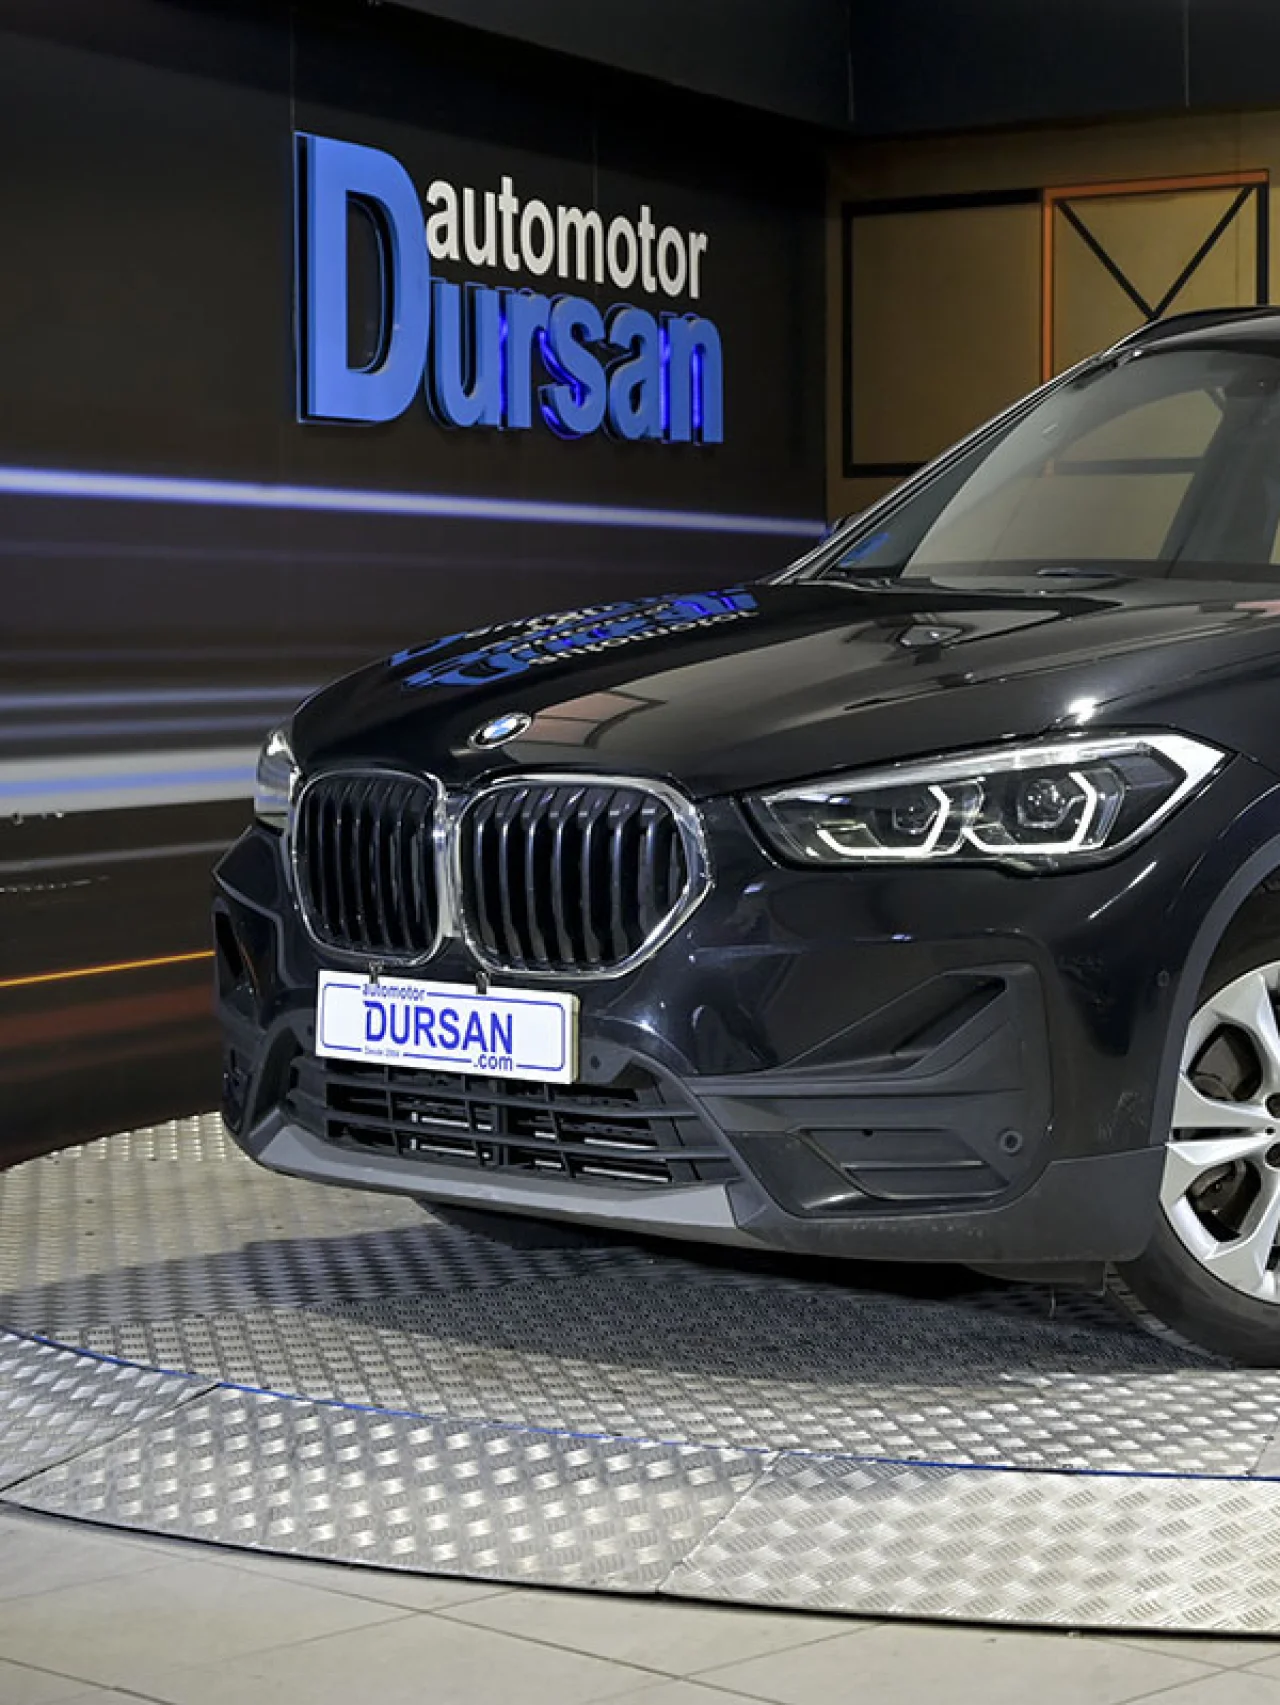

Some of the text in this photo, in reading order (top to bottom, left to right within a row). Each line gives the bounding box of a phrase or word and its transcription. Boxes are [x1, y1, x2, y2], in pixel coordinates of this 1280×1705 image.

[426, 176, 707, 299] automotor
[294, 131, 723, 445] Dursan
[363, 1000, 513, 1055] DURSAN
[473, 1053, 513, 1071] .com
